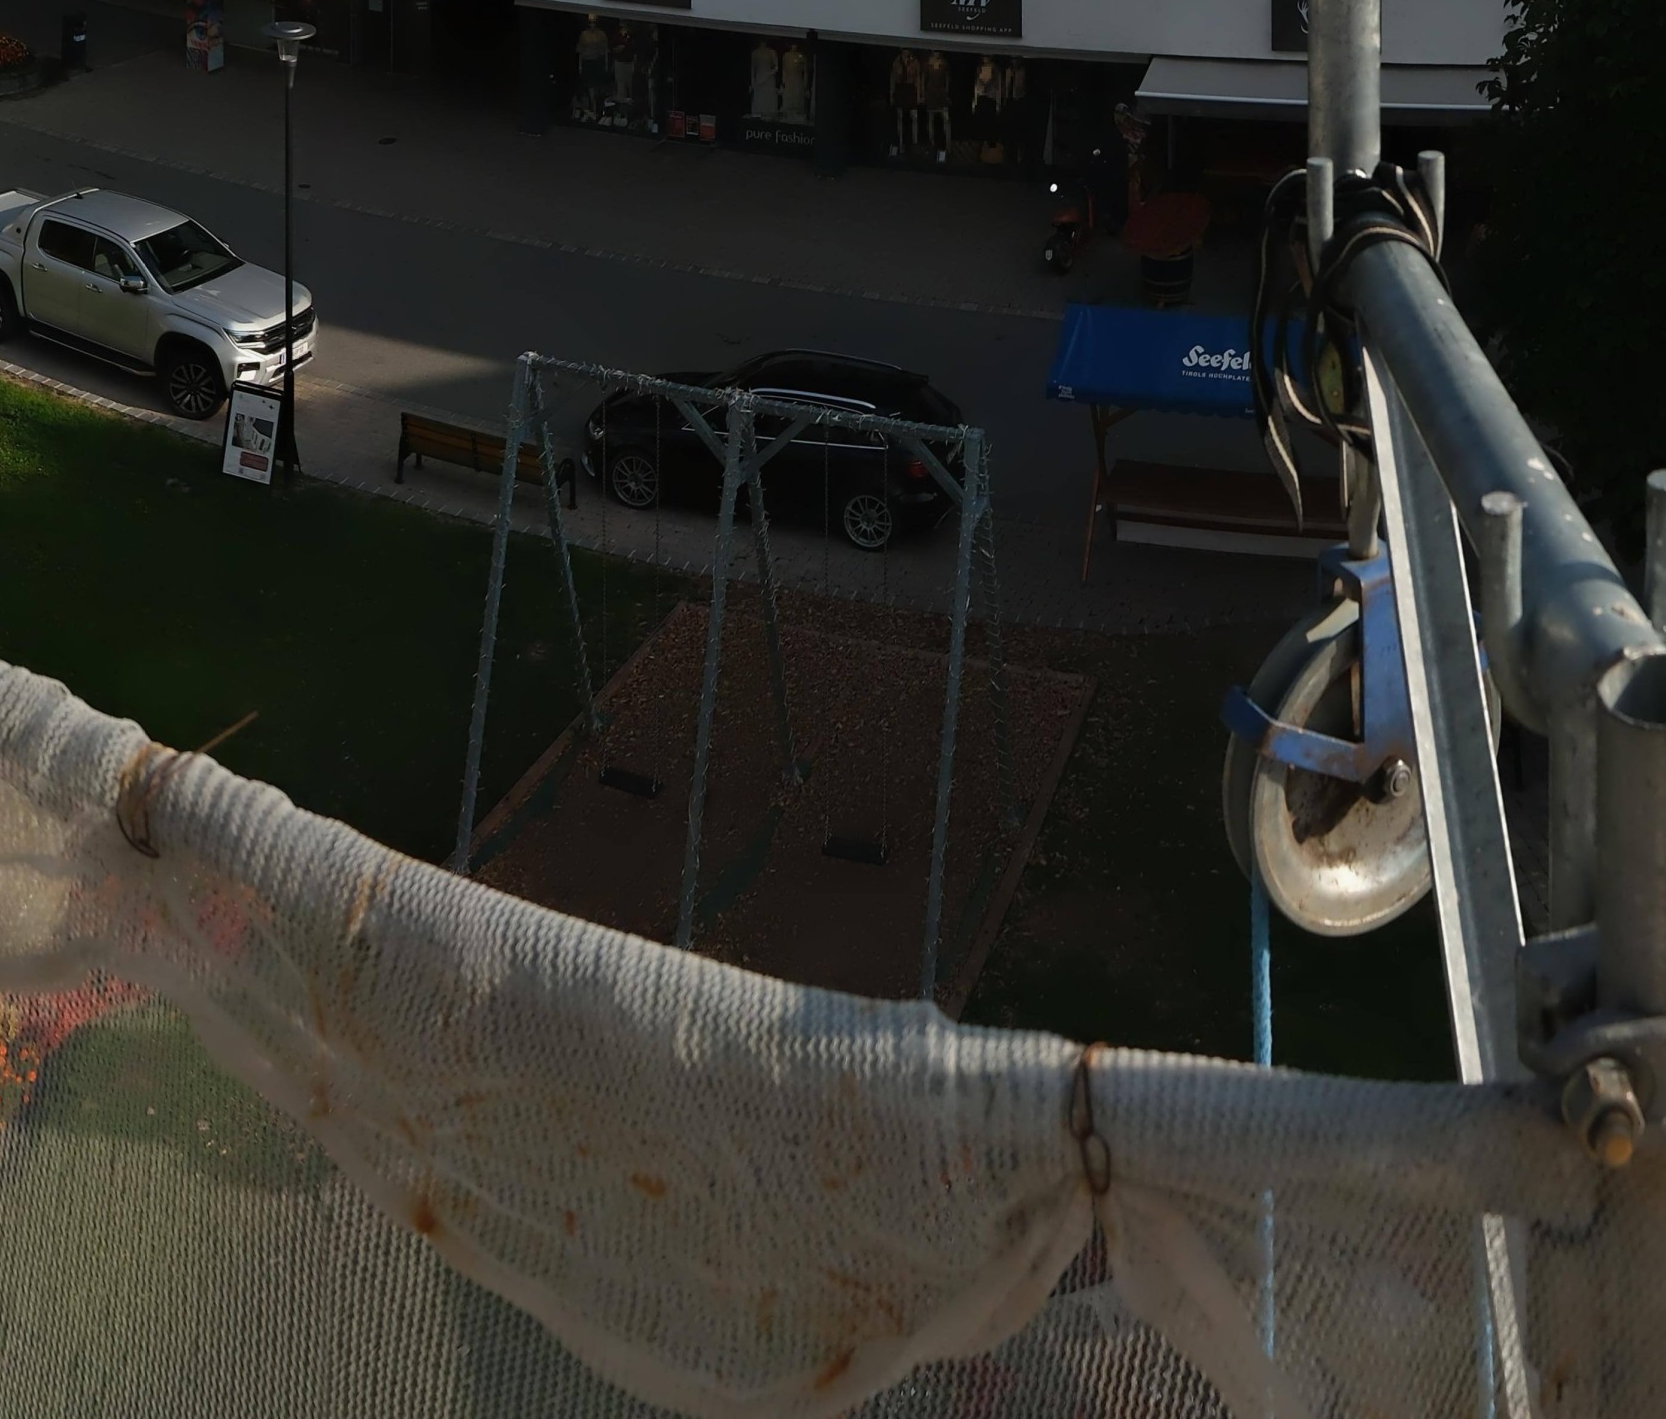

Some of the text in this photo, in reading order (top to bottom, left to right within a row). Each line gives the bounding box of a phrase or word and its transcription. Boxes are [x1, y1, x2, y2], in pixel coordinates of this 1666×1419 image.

[931, 22, 959, 30] SEEFELD
[962, 24, 997, 33] SHOPPING
[746, 129, 771, 140] pure
[1183, 344, 1252, 371] Seefel
[1182, 370, 1206, 378] TIROLS
